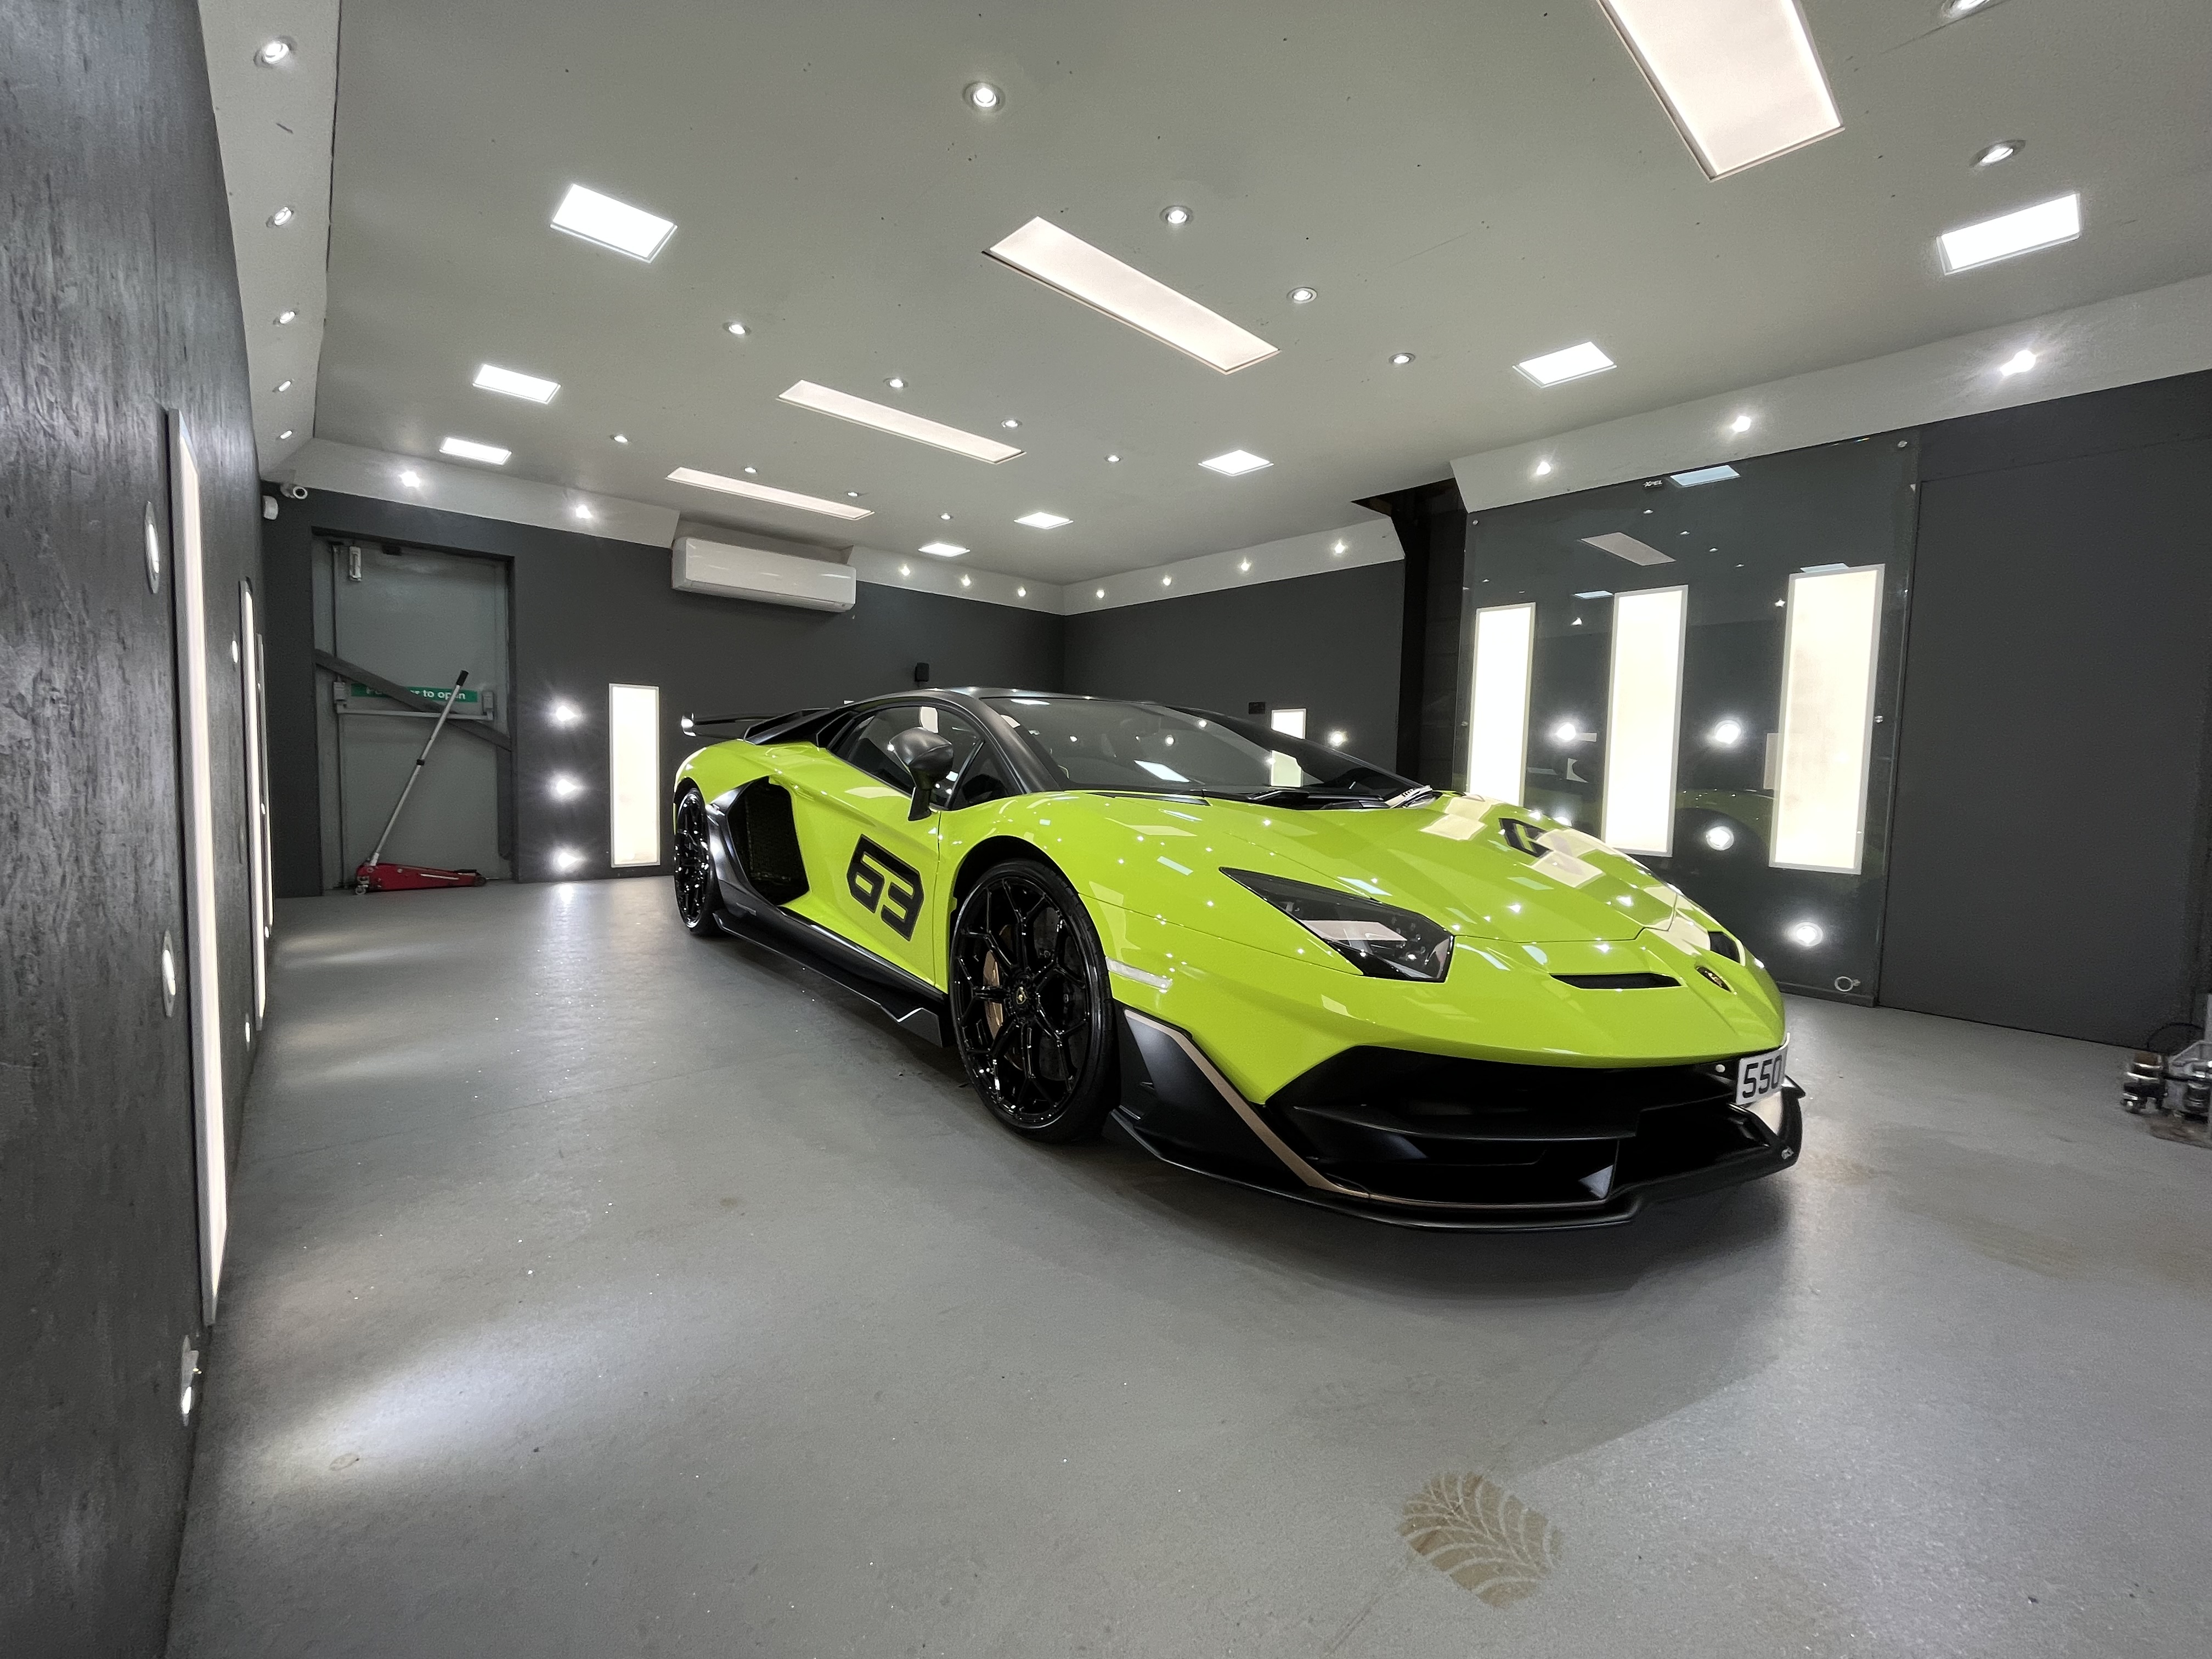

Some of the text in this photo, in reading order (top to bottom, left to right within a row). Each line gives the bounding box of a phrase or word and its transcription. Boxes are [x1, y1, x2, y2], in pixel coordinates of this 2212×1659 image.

[423, 690, 435, 698] to
[437, 692, 466, 700] opn
[847, 833, 924, 941] 63
